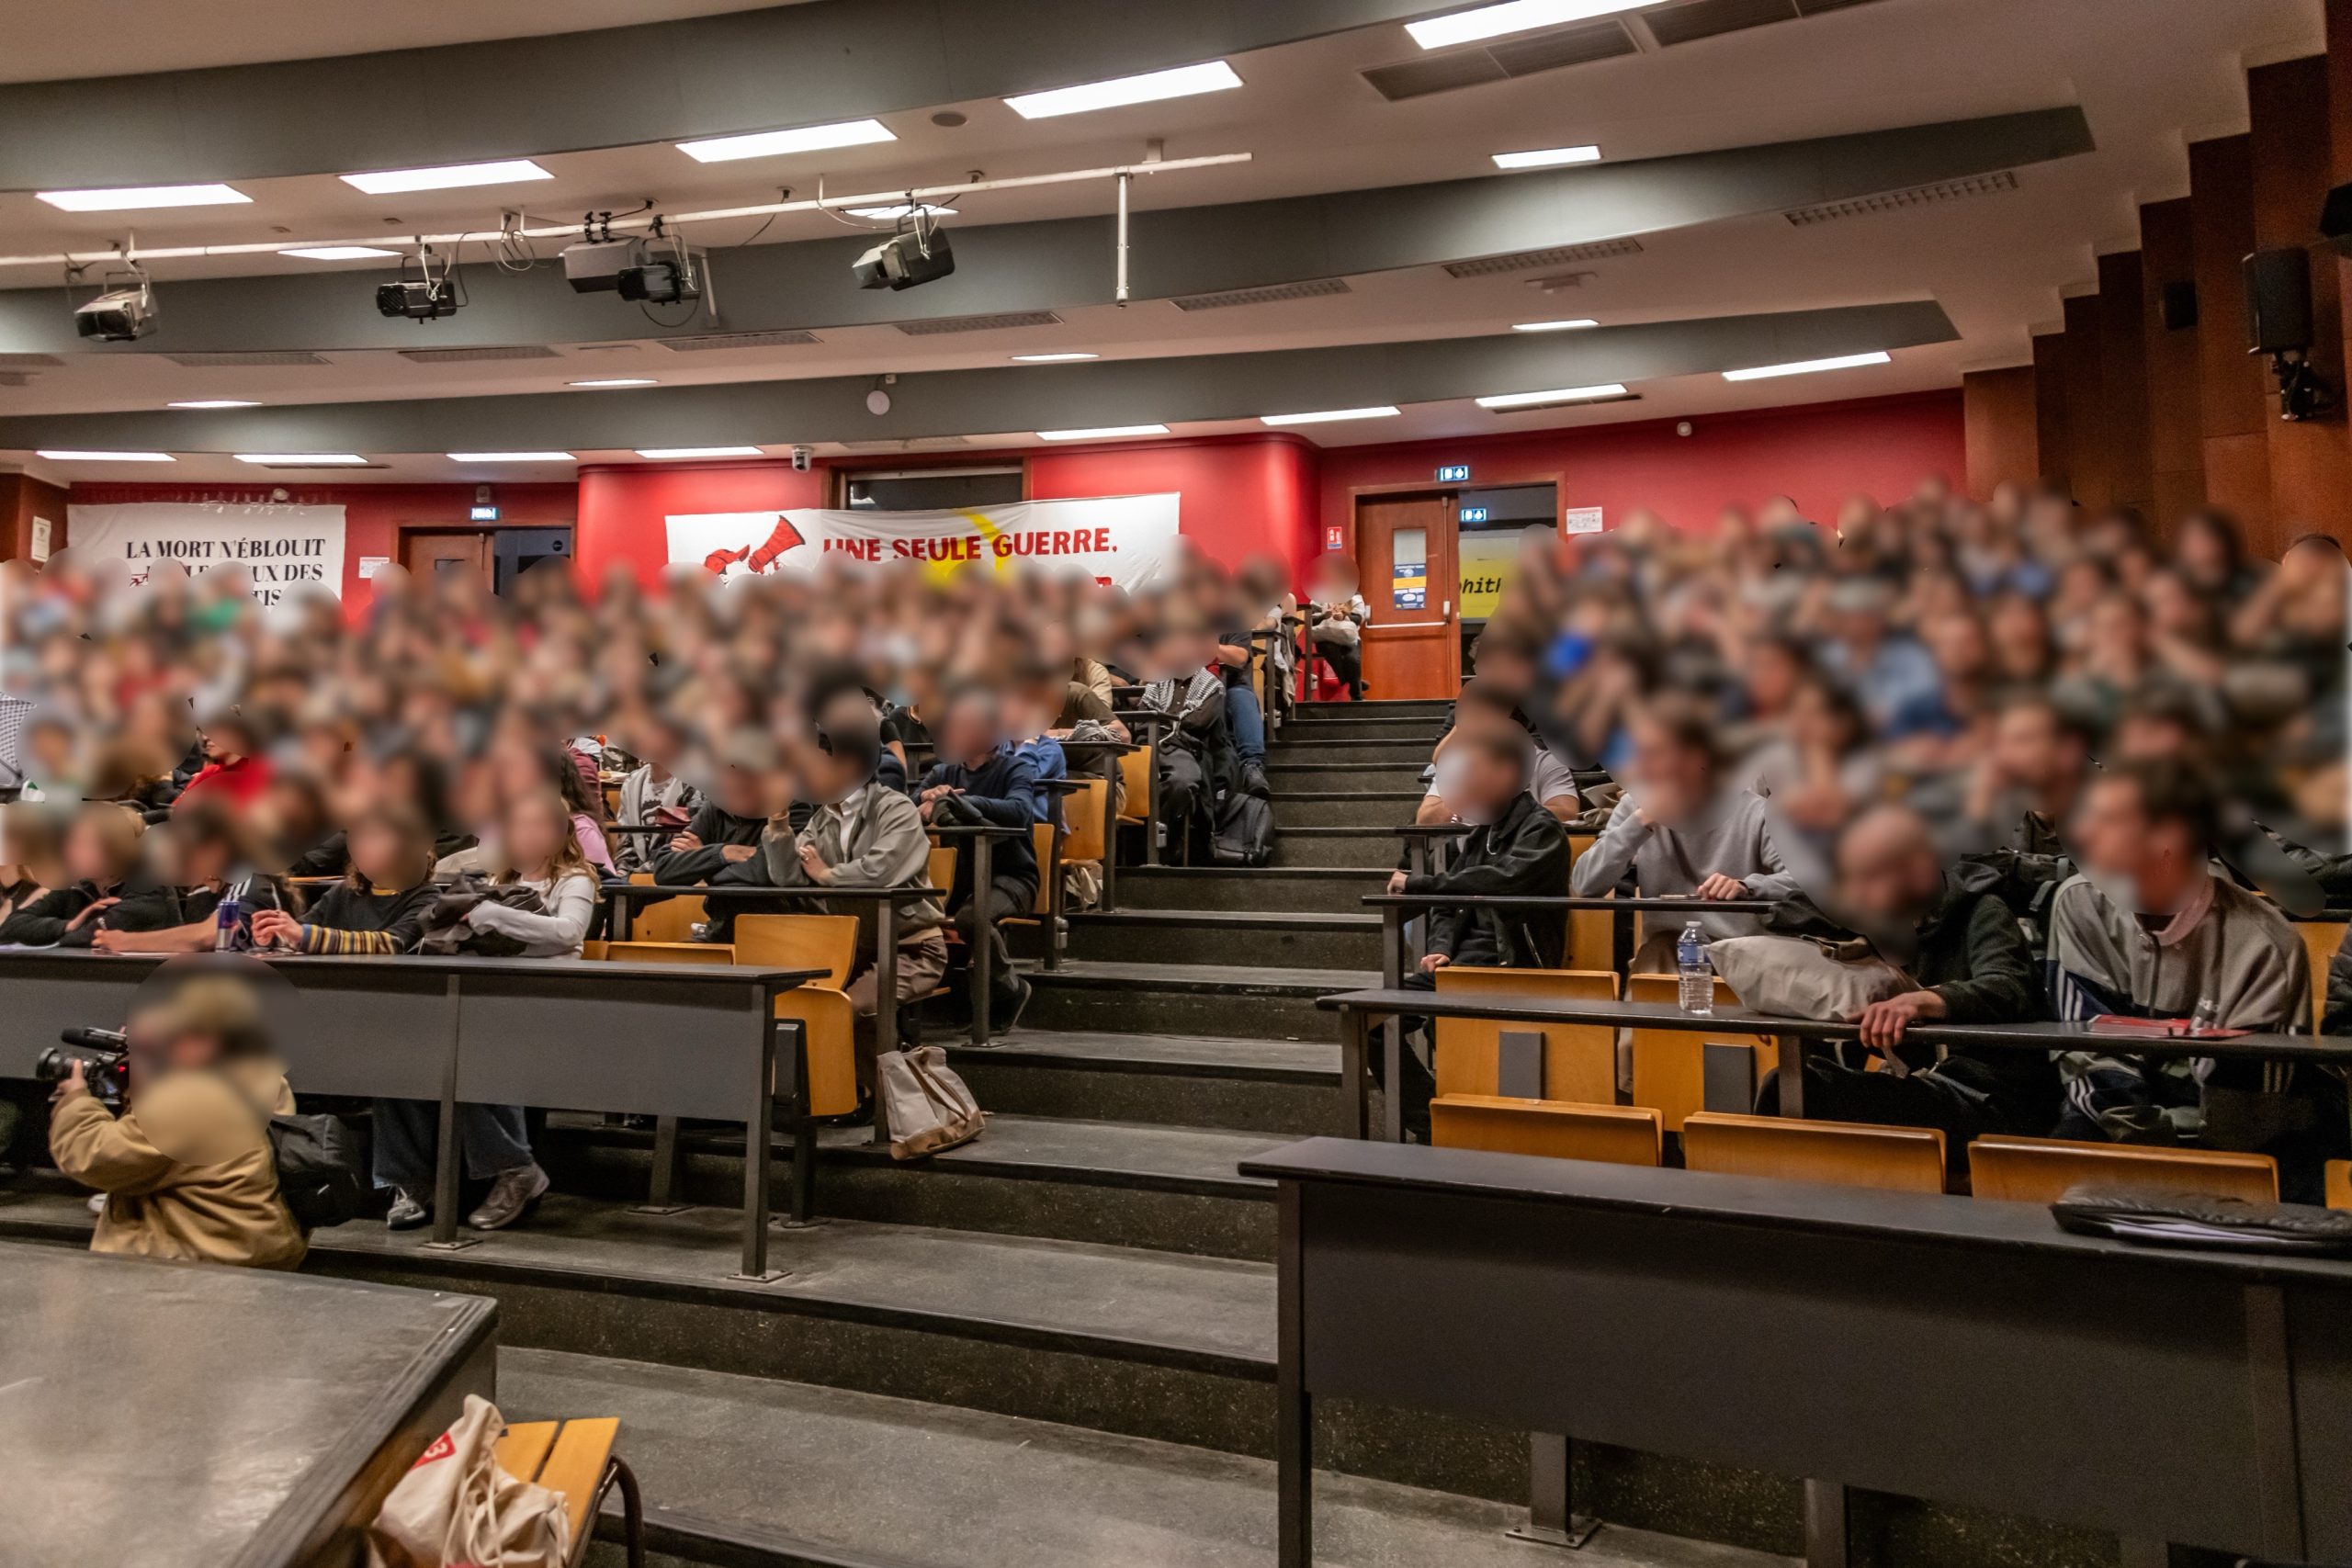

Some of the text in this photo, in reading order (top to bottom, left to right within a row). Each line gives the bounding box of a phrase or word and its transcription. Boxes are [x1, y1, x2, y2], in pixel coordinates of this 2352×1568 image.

[126, 537, 326, 558] LA MORT N'ÉBLOUIT
[892, 536, 981, 561] SEULE
[992, 527, 1117, 558] GUERRE.
[284, 563, 322, 581] DES
